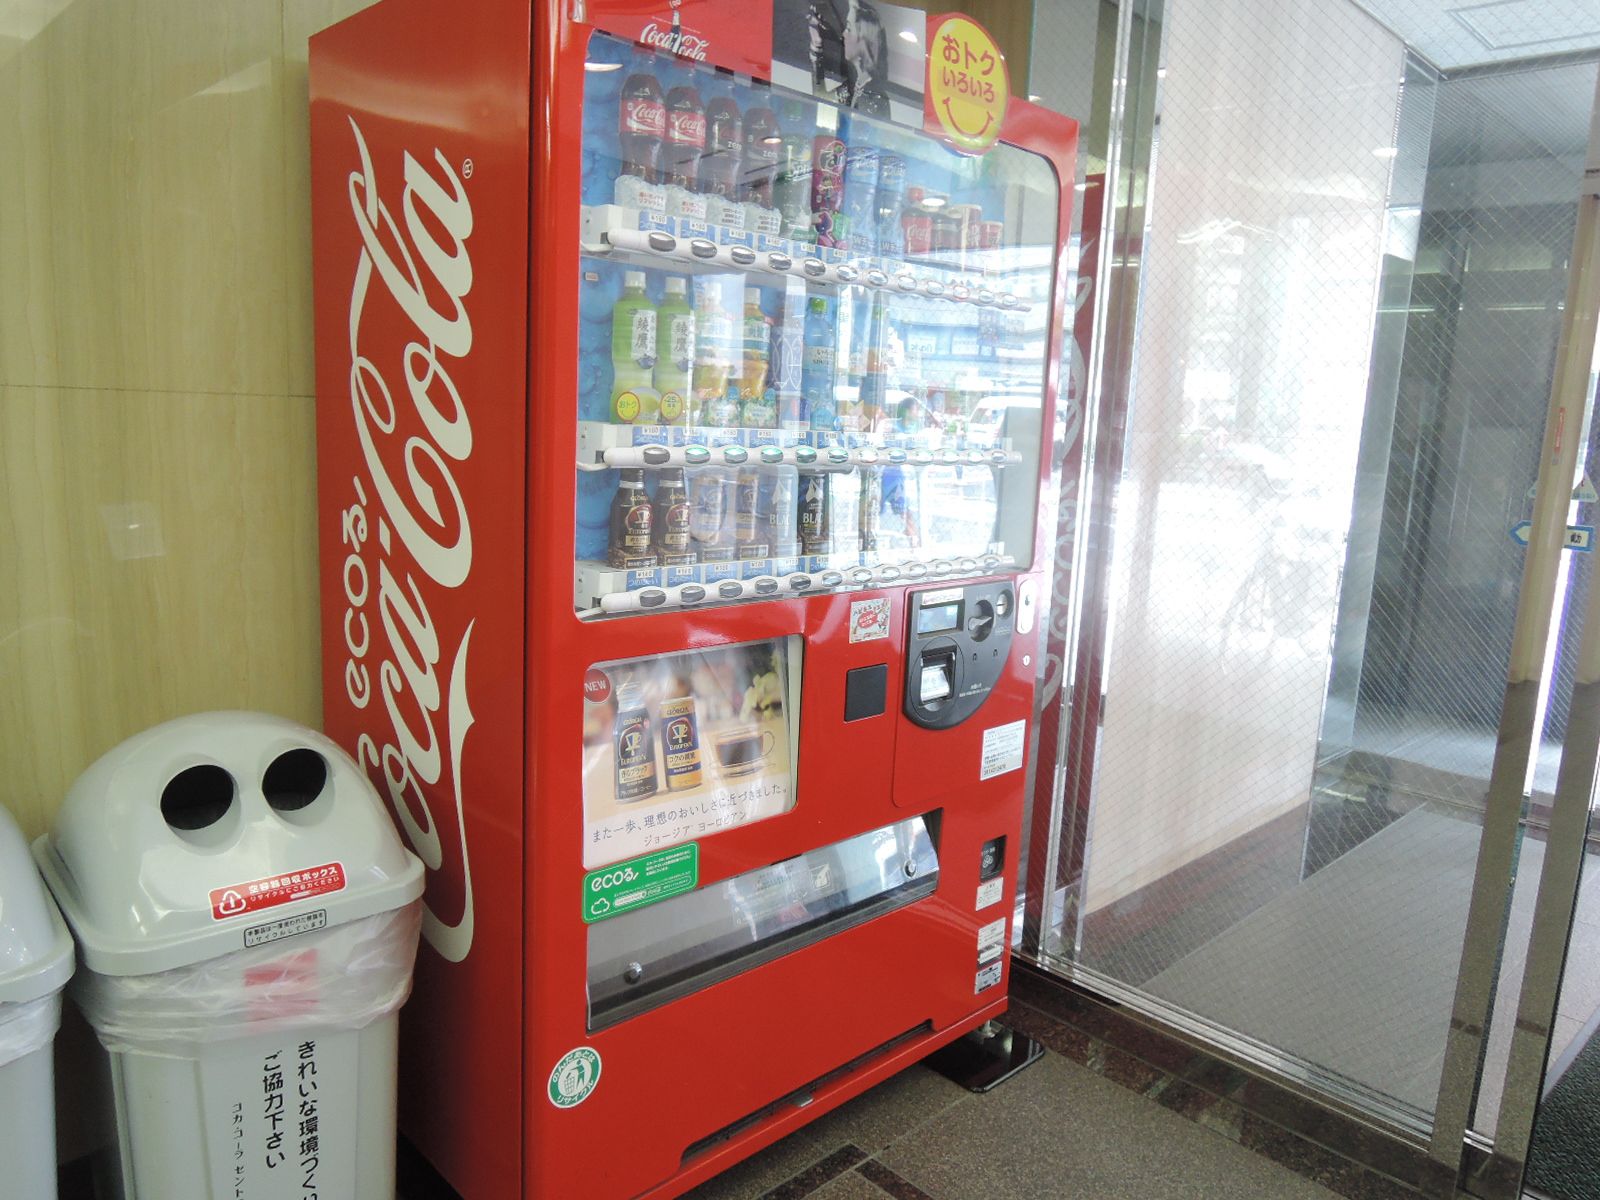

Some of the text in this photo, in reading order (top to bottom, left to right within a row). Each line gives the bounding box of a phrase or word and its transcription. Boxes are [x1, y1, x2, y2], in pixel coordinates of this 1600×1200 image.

[942, 34, 995, 75] おトク
[943, 66, 995, 103] いろいろ
[585, 680, 606, 692] NEW
[643, 811, 747, 847] ジョージア ヨーロピアン
[263, 1050, 285, 1168] ご協力下さい
[234, 1165, 245, 1200] セント
